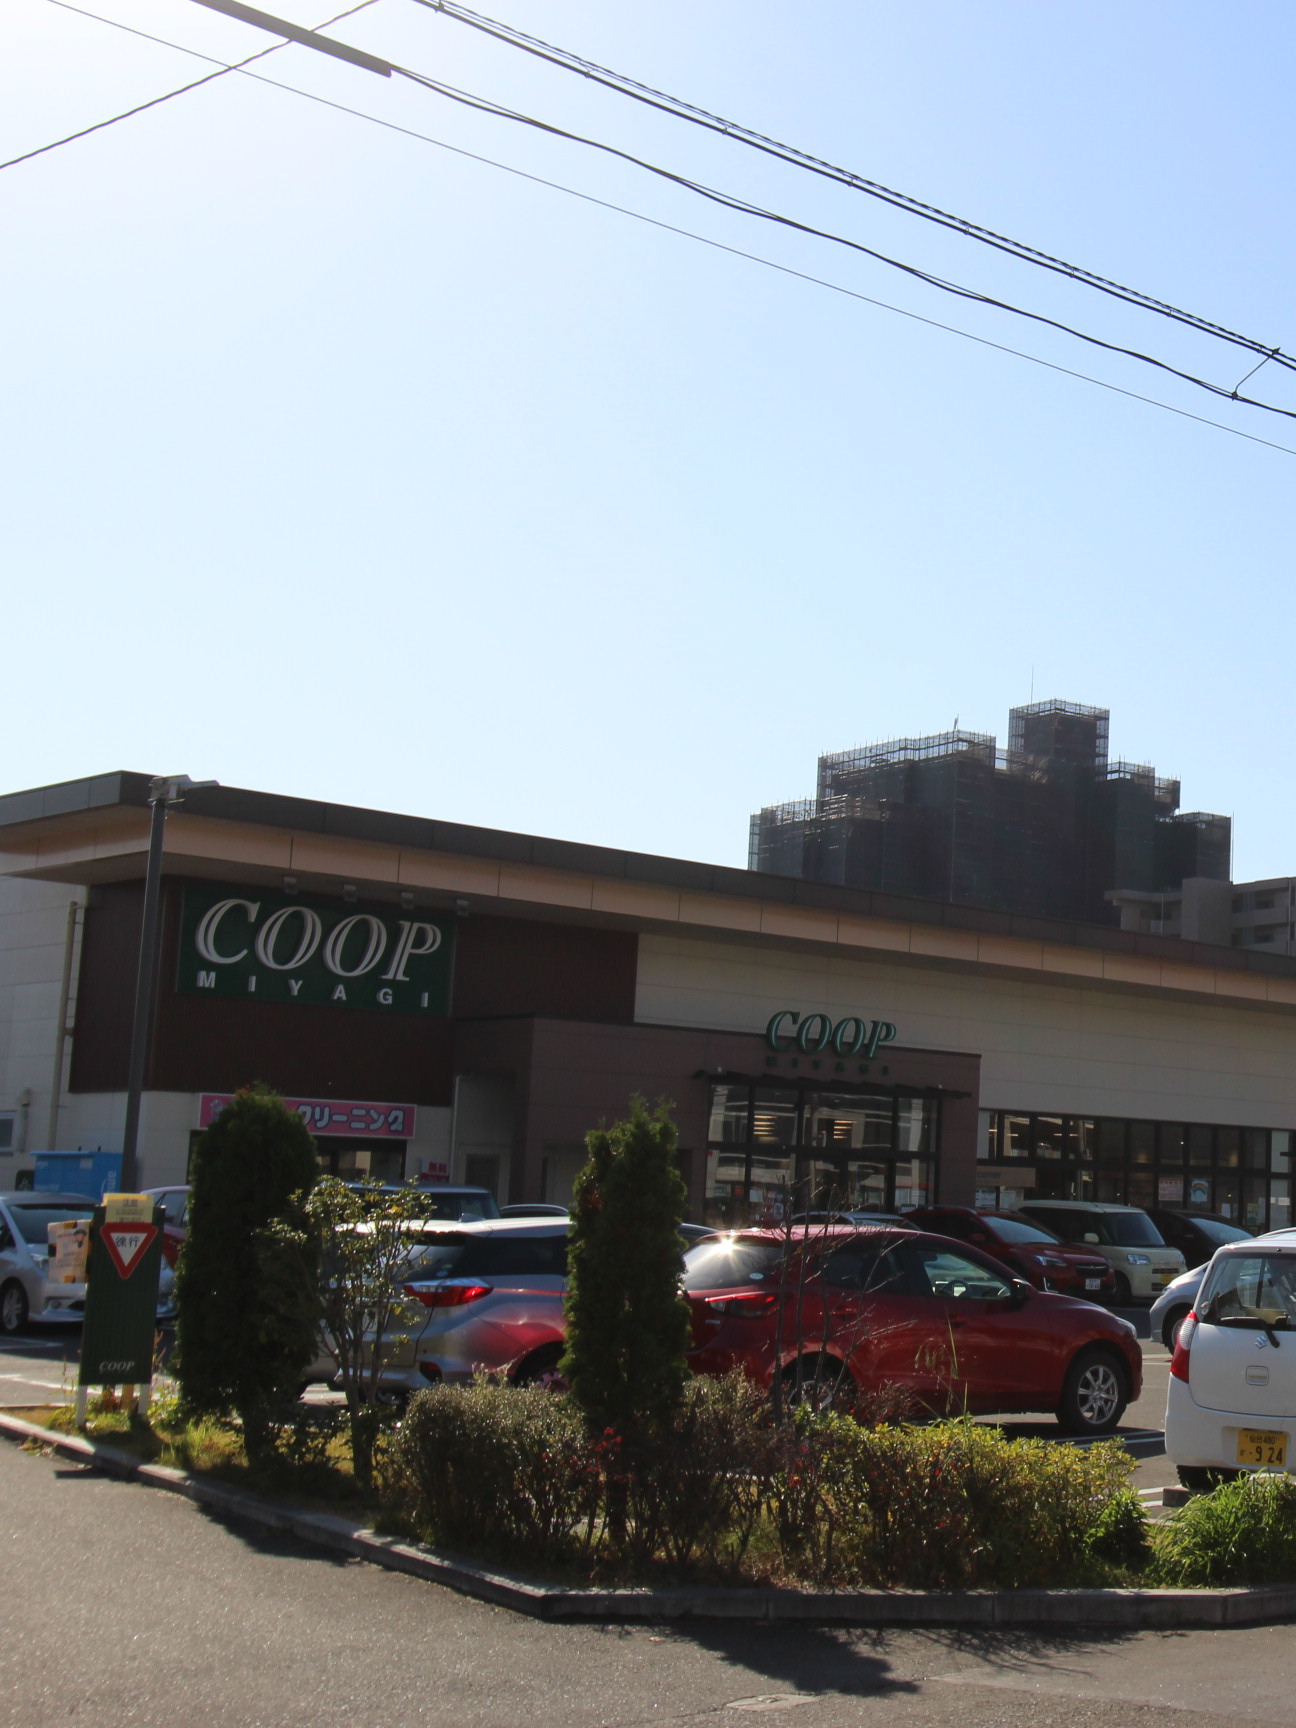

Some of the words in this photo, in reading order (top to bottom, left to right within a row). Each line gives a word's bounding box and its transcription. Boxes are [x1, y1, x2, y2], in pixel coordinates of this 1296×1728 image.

[195, 898, 442, 981] COOP
[196, 970, 429, 1008] MIYAGI
[766, 1010, 897, 1059] COOP
[297, 1104, 405, 1134] クリーニング
[115, 1236, 140, 1248] 徐行
[99, 1361, 135, 1373] COOP
